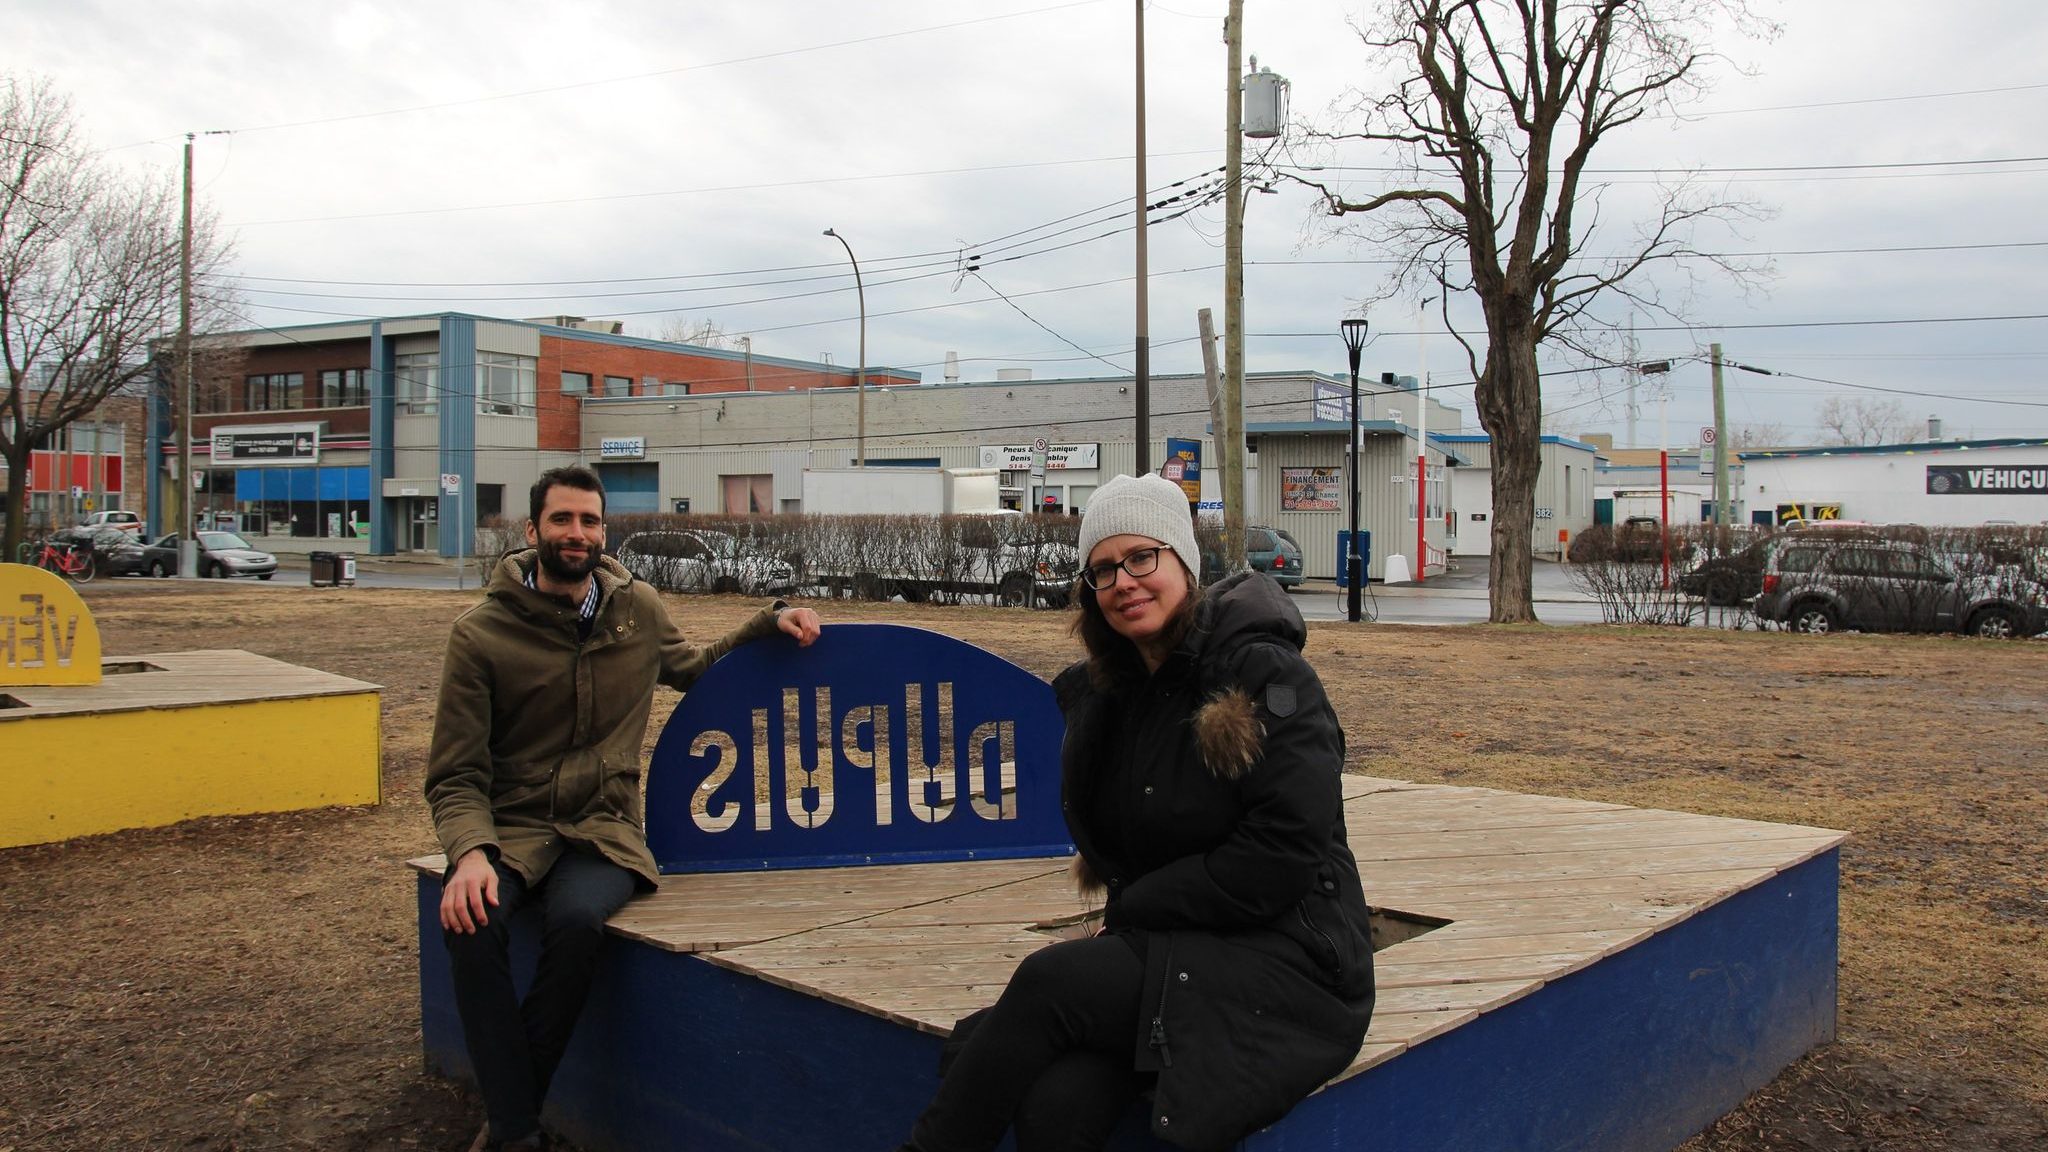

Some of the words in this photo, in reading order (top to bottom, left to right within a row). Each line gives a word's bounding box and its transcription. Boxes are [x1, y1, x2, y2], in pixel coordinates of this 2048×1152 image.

[603, 441, 640, 454] SERVICE
[1048, 445, 1078, 453] canique
[1047, 454, 1068, 462] mblay
[1285, 475, 1339, 484] FINANCEMENT
